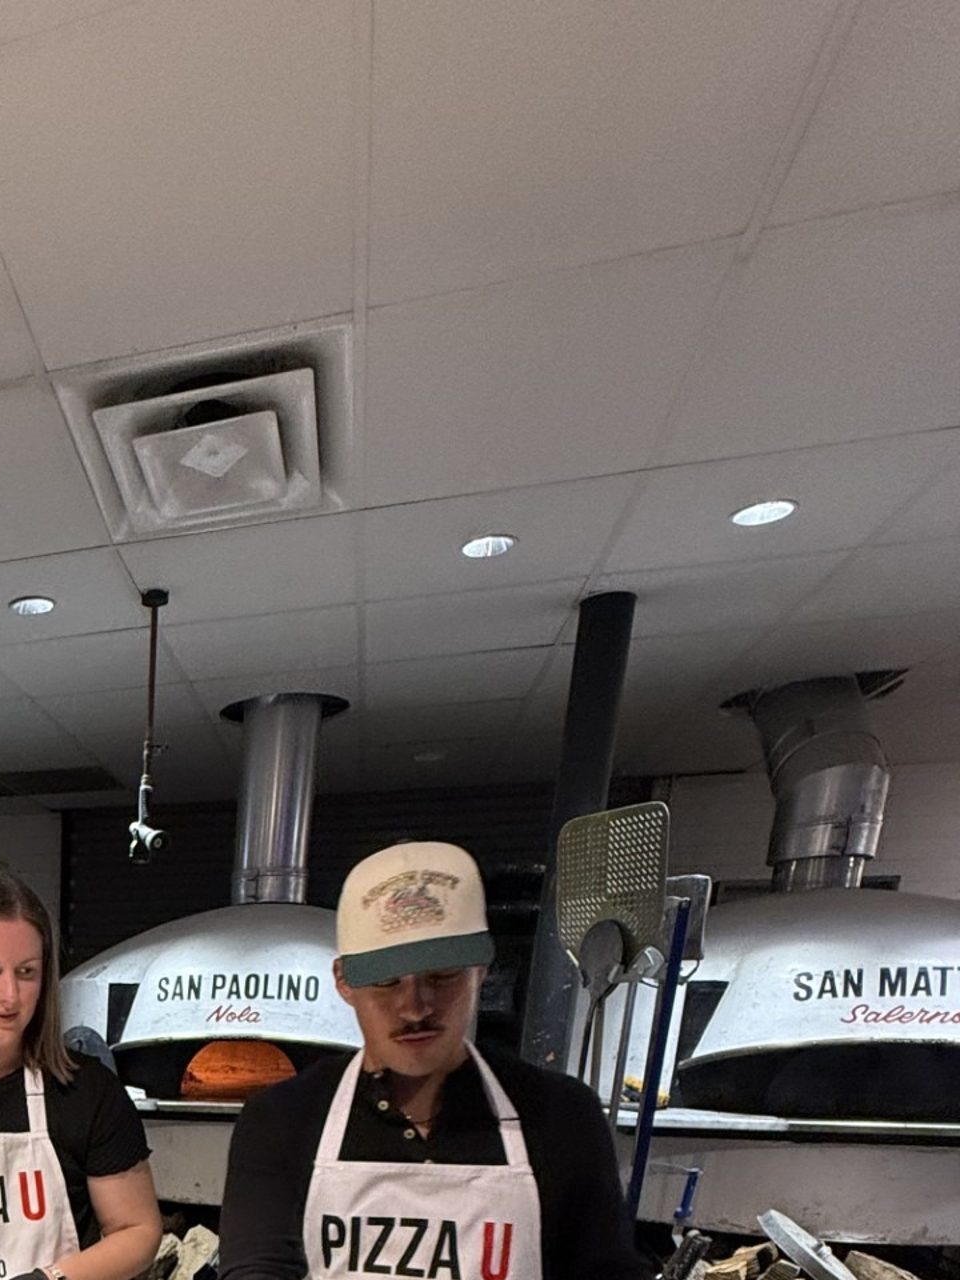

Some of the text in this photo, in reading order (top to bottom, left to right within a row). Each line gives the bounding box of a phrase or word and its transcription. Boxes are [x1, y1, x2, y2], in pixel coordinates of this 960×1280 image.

[157, 973, 320, 1001] SAN PAOLINO
[793, 966, 960, 1001] SAN MAT
[206, 1004, 262, 1023] Nola
[18, 1170, 46, 1221] U
[321, 1214, 462, 1280] PIZZA
